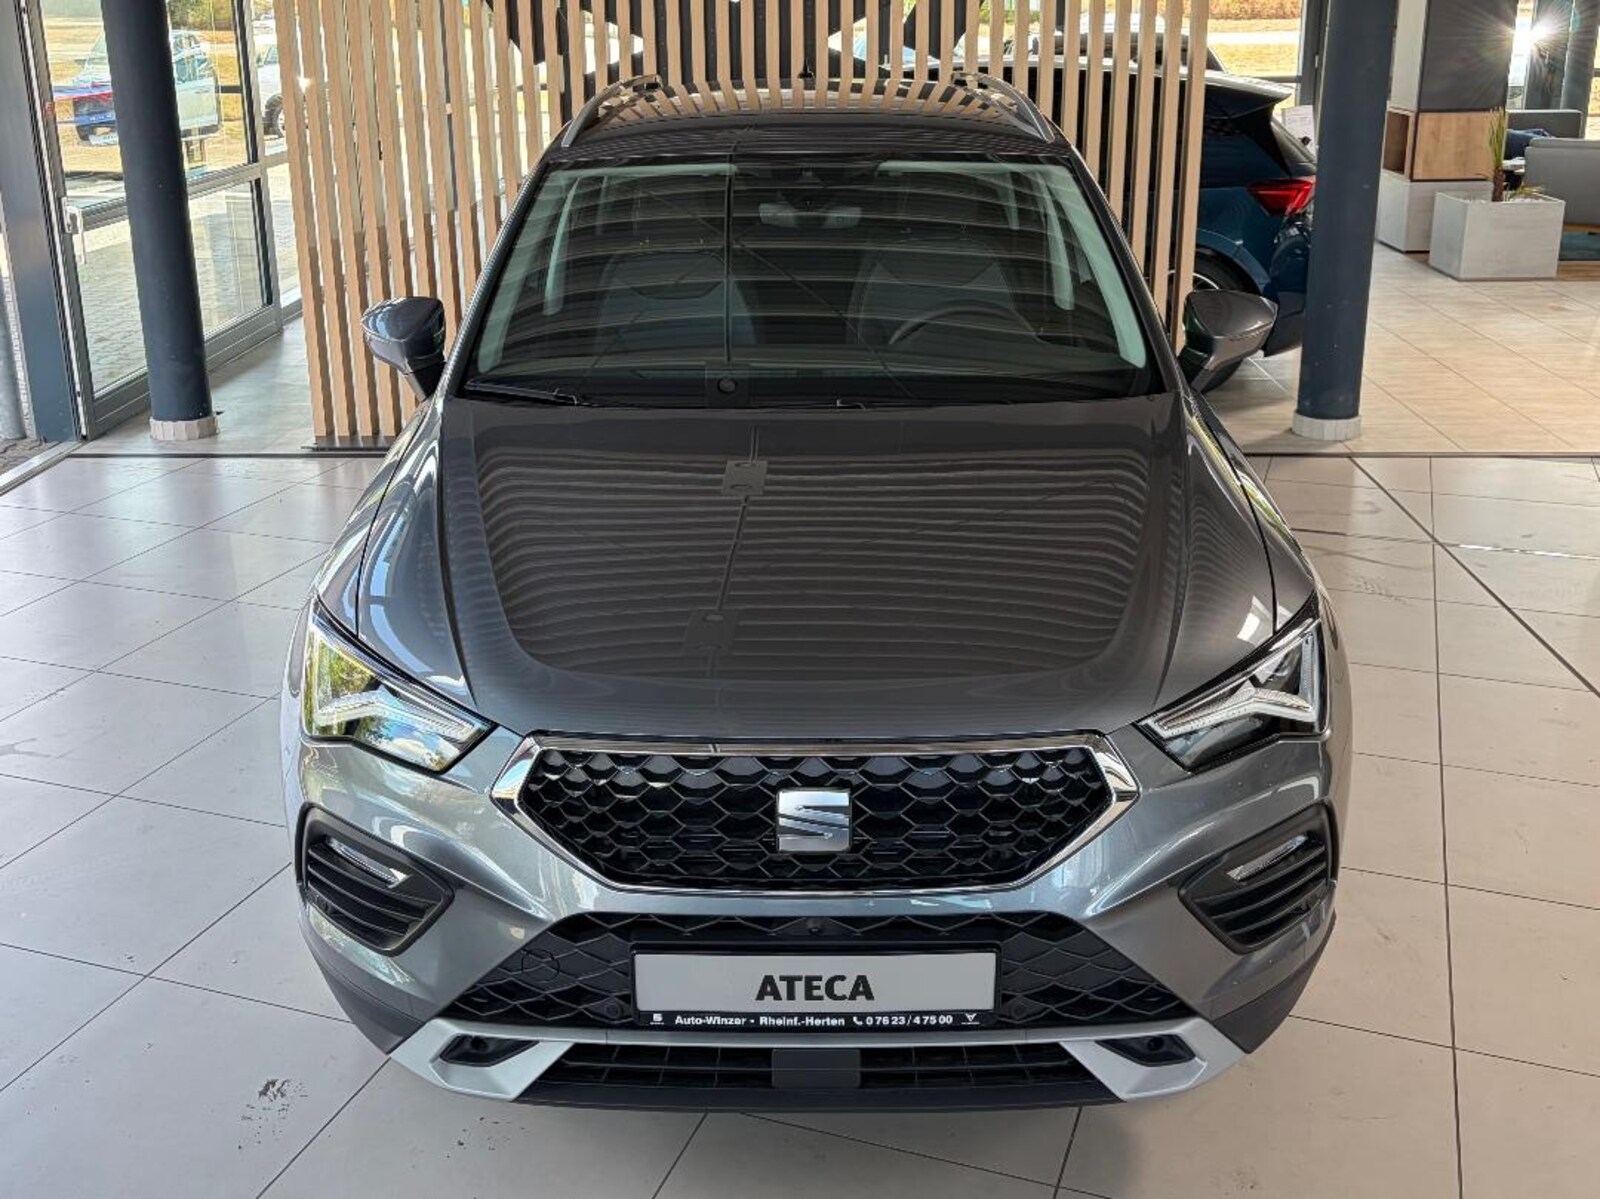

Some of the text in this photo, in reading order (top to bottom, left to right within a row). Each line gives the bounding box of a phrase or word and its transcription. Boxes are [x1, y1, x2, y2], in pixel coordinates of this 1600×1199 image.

[755, 974, 875, 1001] ATECA
[674, 1015, 747, 1025] Auto-Winzer
[759, 1016, 845, 1026] Rheinf.-Herten
